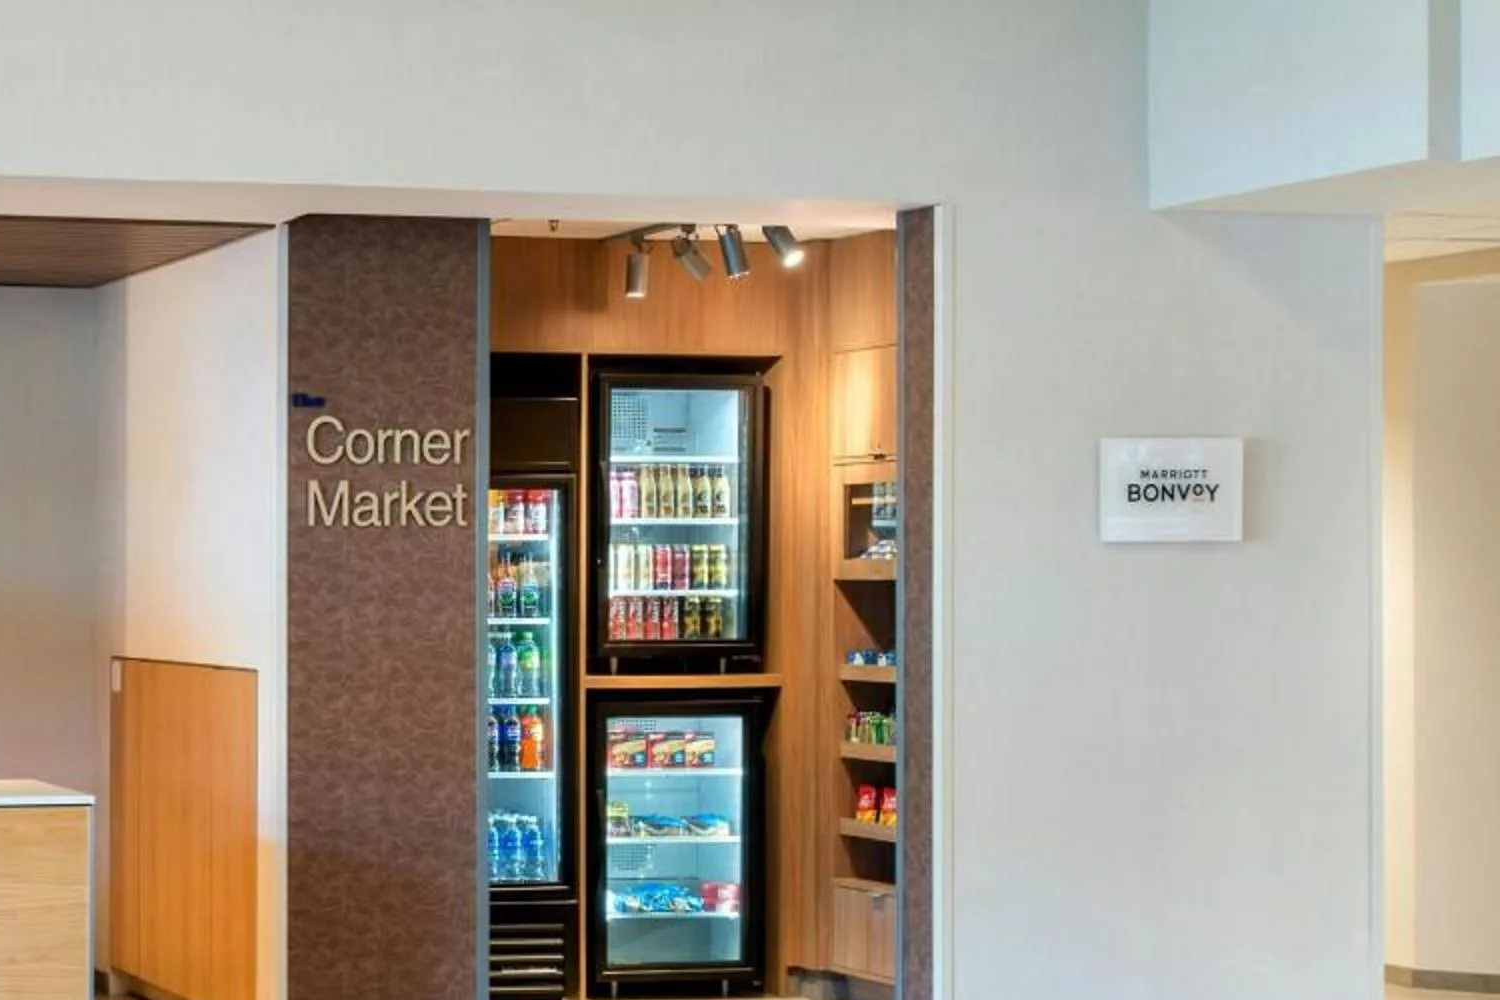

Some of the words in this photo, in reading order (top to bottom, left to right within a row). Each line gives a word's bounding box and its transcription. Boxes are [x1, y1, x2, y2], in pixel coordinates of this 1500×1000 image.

[306, 415, 471, 465] Corner
[1139, 469, 1209, 479] MARRIOTT
[307, 480, 468, 527] Market
[1127, 483, 1220, 502] BONVOY
